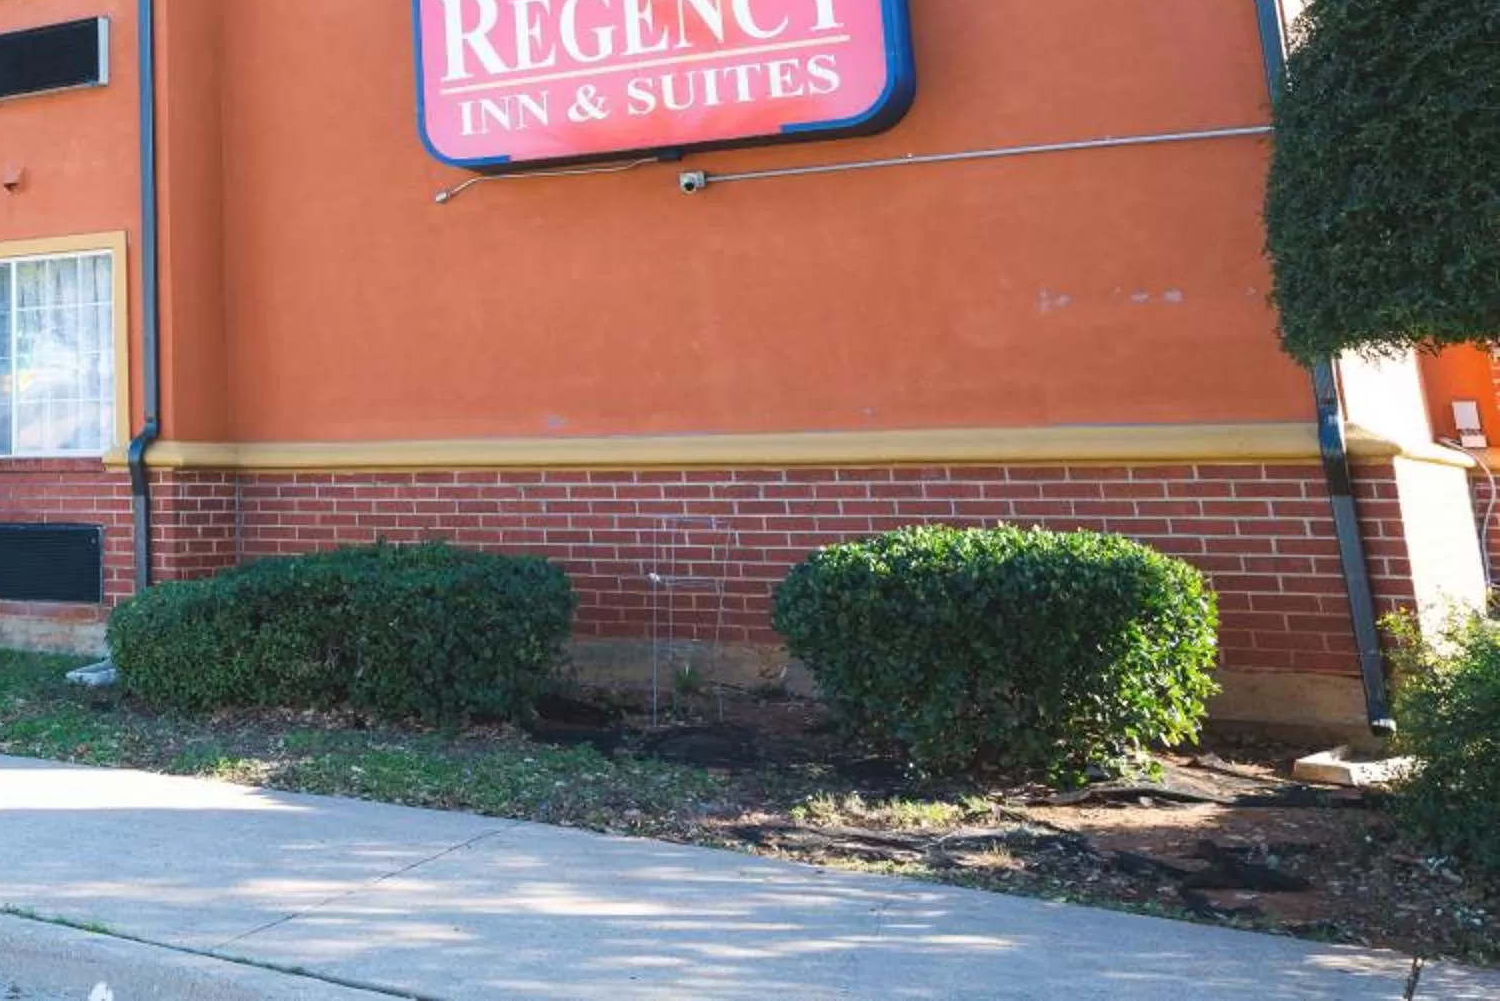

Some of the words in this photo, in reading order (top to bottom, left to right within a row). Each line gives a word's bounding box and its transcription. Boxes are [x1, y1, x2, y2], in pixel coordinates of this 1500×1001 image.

[460, 90, 549, 137] INN
[567, 84, 610, 123] &
[626, 54, 841, 116] SUITES
